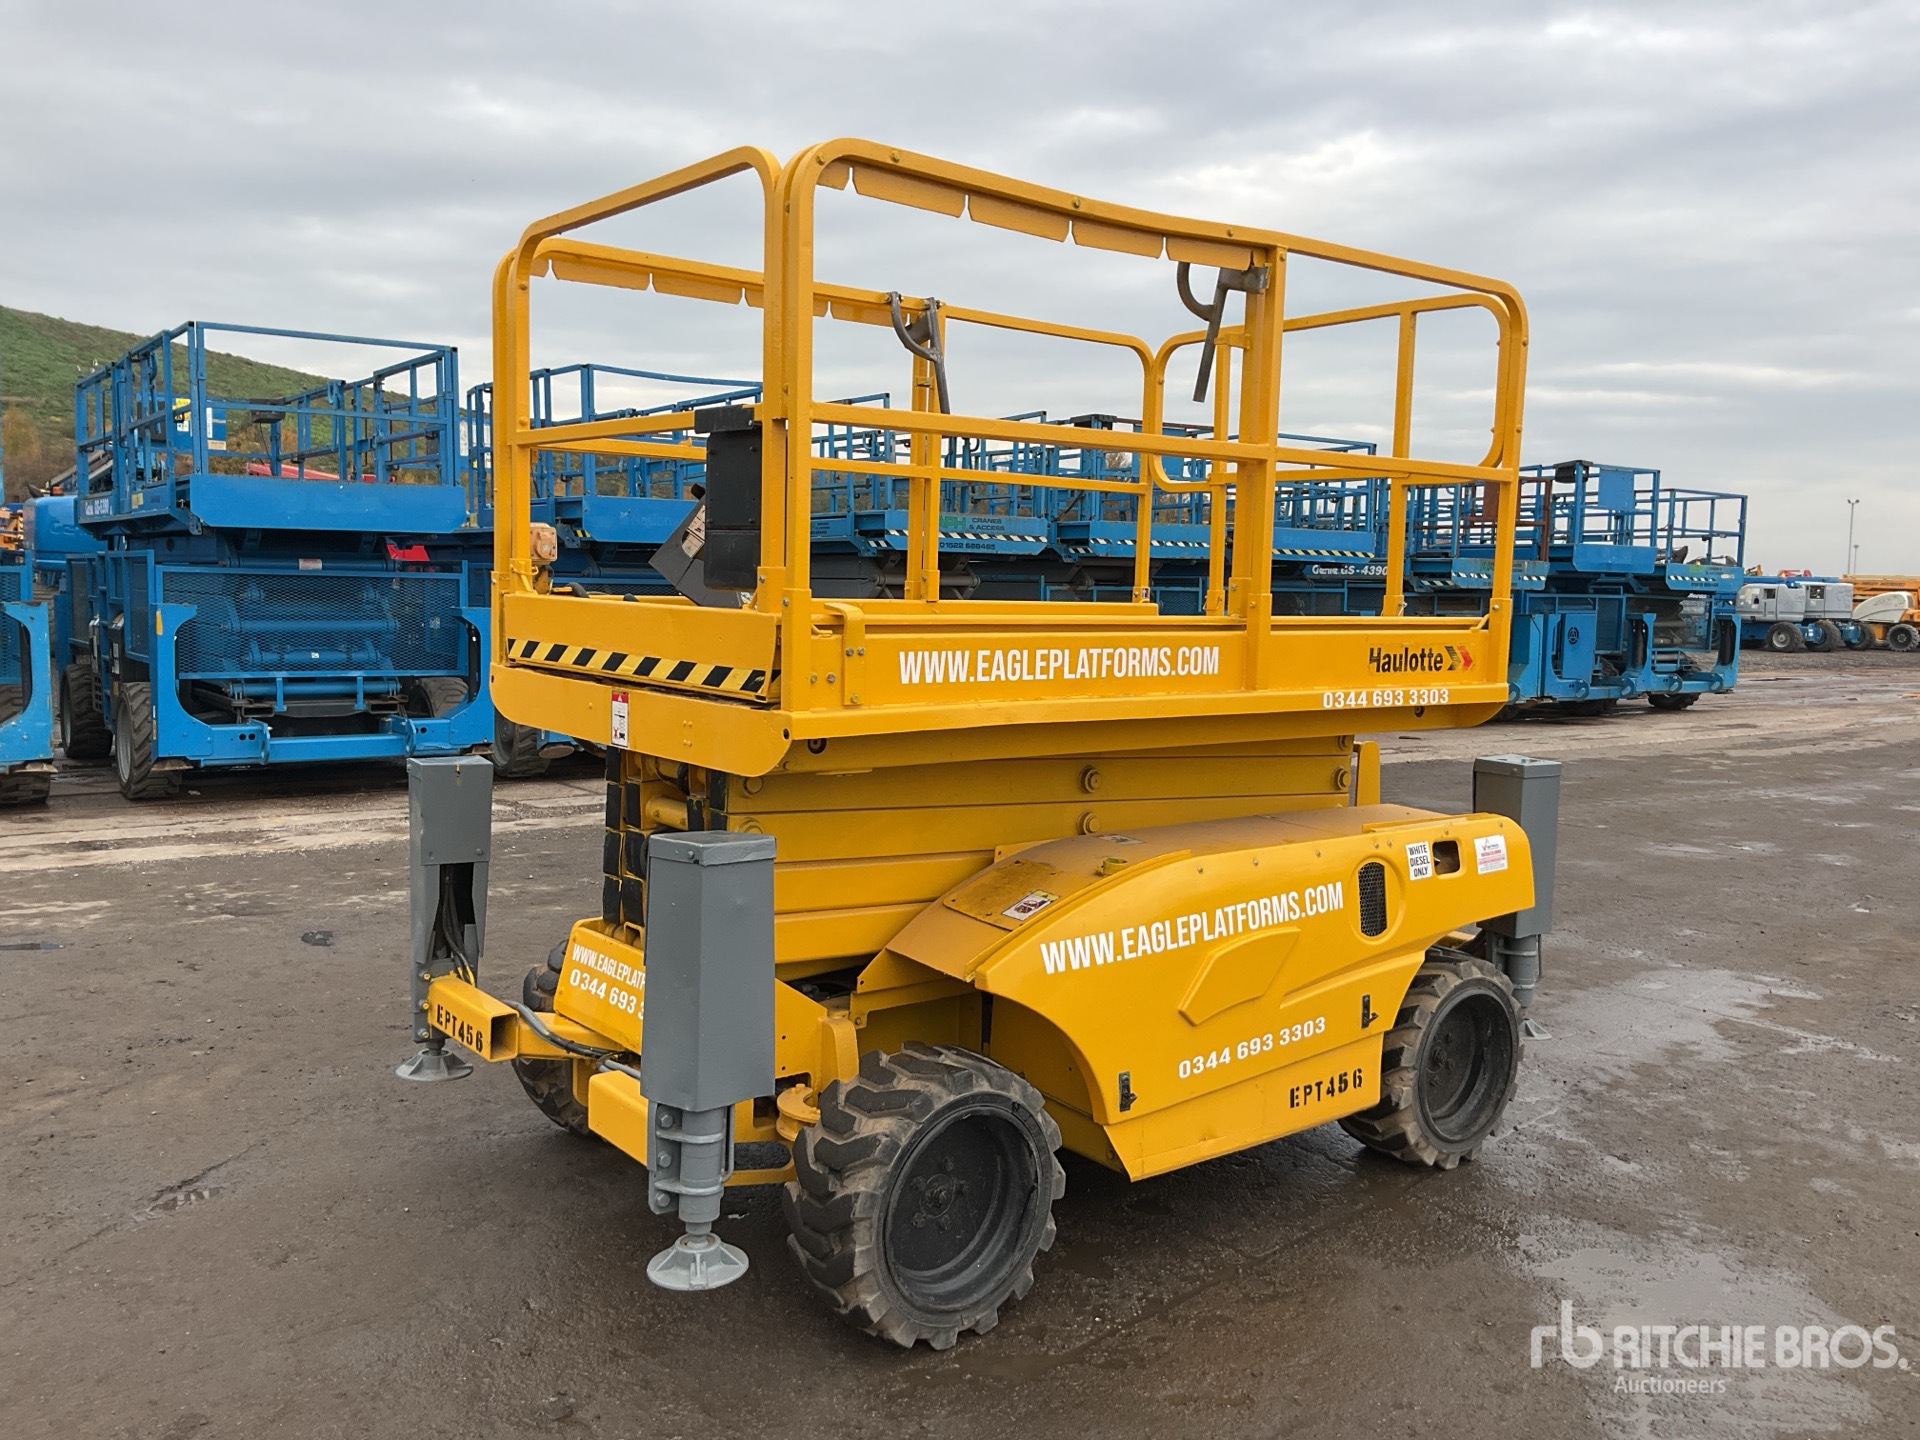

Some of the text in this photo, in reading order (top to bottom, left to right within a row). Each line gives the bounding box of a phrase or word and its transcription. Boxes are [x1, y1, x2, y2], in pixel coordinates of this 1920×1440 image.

[972, 517, 1002, 525] CRANES
[900, 646, 1220, 684] WWW.EAGLEPLATFORMS.COM
[1369, 647, 1443, 672] Haulotte
[1323, 688, 1449, 708] 0344 693 3303
[1408, 844, 1428, 856] WHITE
[1410, 855, 1430, 867] DIESEL
[1413, 866, 1428, 878] ONLY
[1040, 881, 1344, 974] WWW.EAGLEPLATFORMS.COM
[569, 968, 607, 999] 0344
[609, 987, 637, 1014] 693
[1178, 1016, 1326, 1078] 0344 693 3303
